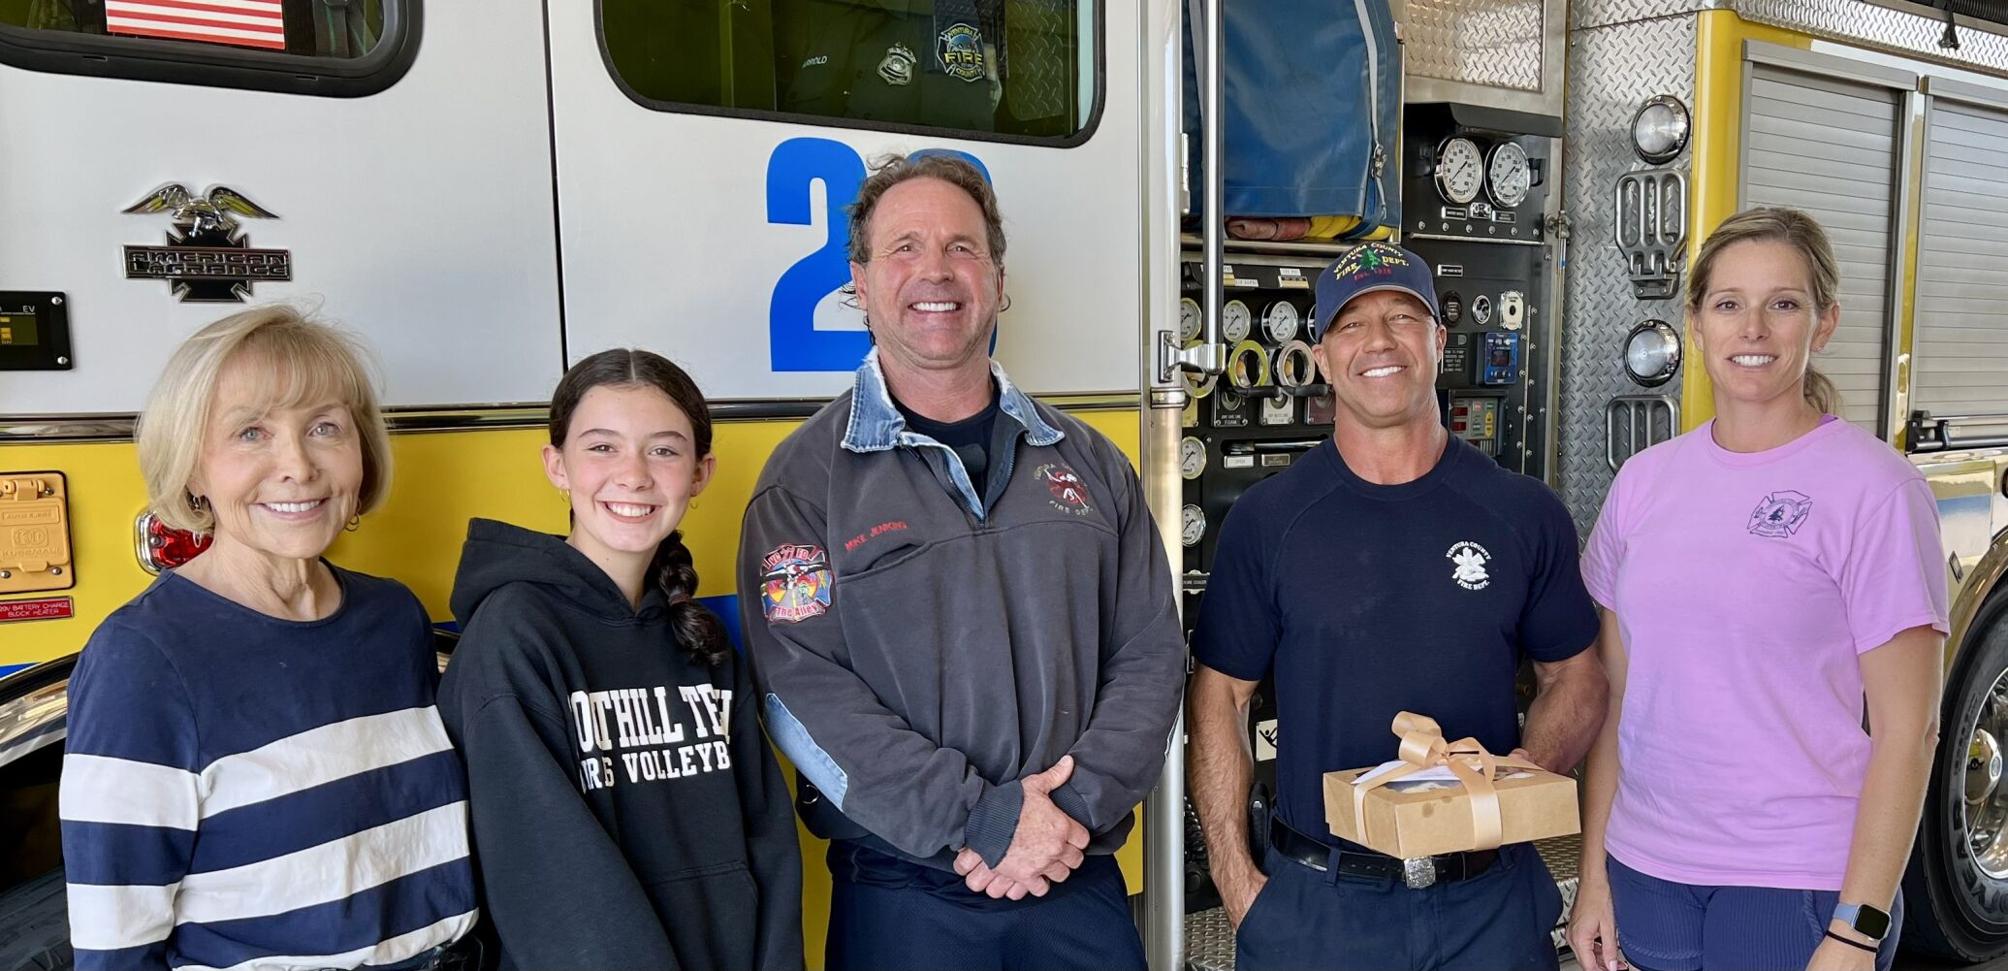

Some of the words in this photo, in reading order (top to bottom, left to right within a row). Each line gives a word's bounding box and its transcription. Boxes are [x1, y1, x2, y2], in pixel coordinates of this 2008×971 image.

[944, 52, 982, 65] FIRE
[1333, 244, 1367, 273] VENTURA
[1370, 242, 1403, 257] COUNTY
[1336, 262, 1357, 280] FIRE
[22, 305, 35, 313] EV
[12, 603, 40, 611] BATTERY
